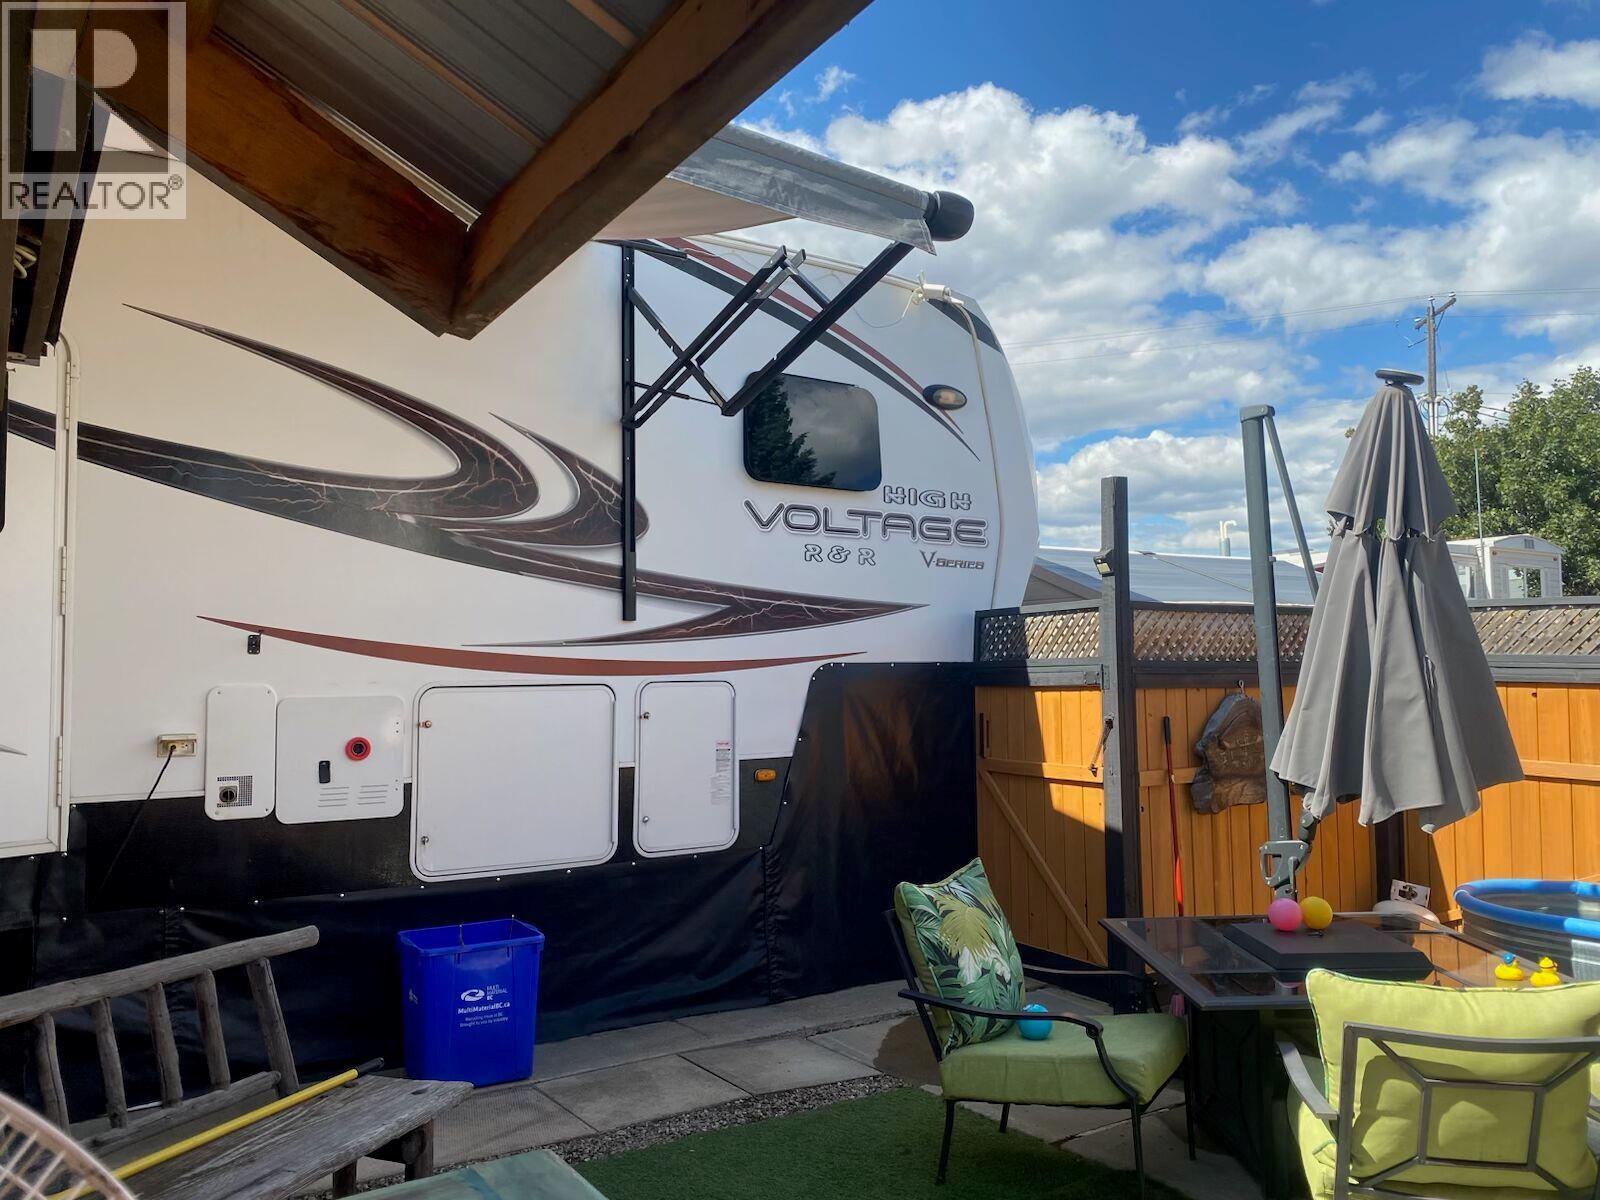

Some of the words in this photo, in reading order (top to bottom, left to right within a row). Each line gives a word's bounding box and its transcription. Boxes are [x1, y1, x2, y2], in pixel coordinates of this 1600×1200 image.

[883, 485, 972, 510] HIGH
[744, 499, 988, 547] VOLTAGE
[457, 1002, 511, 1014] MultiMaterialBC.ca
